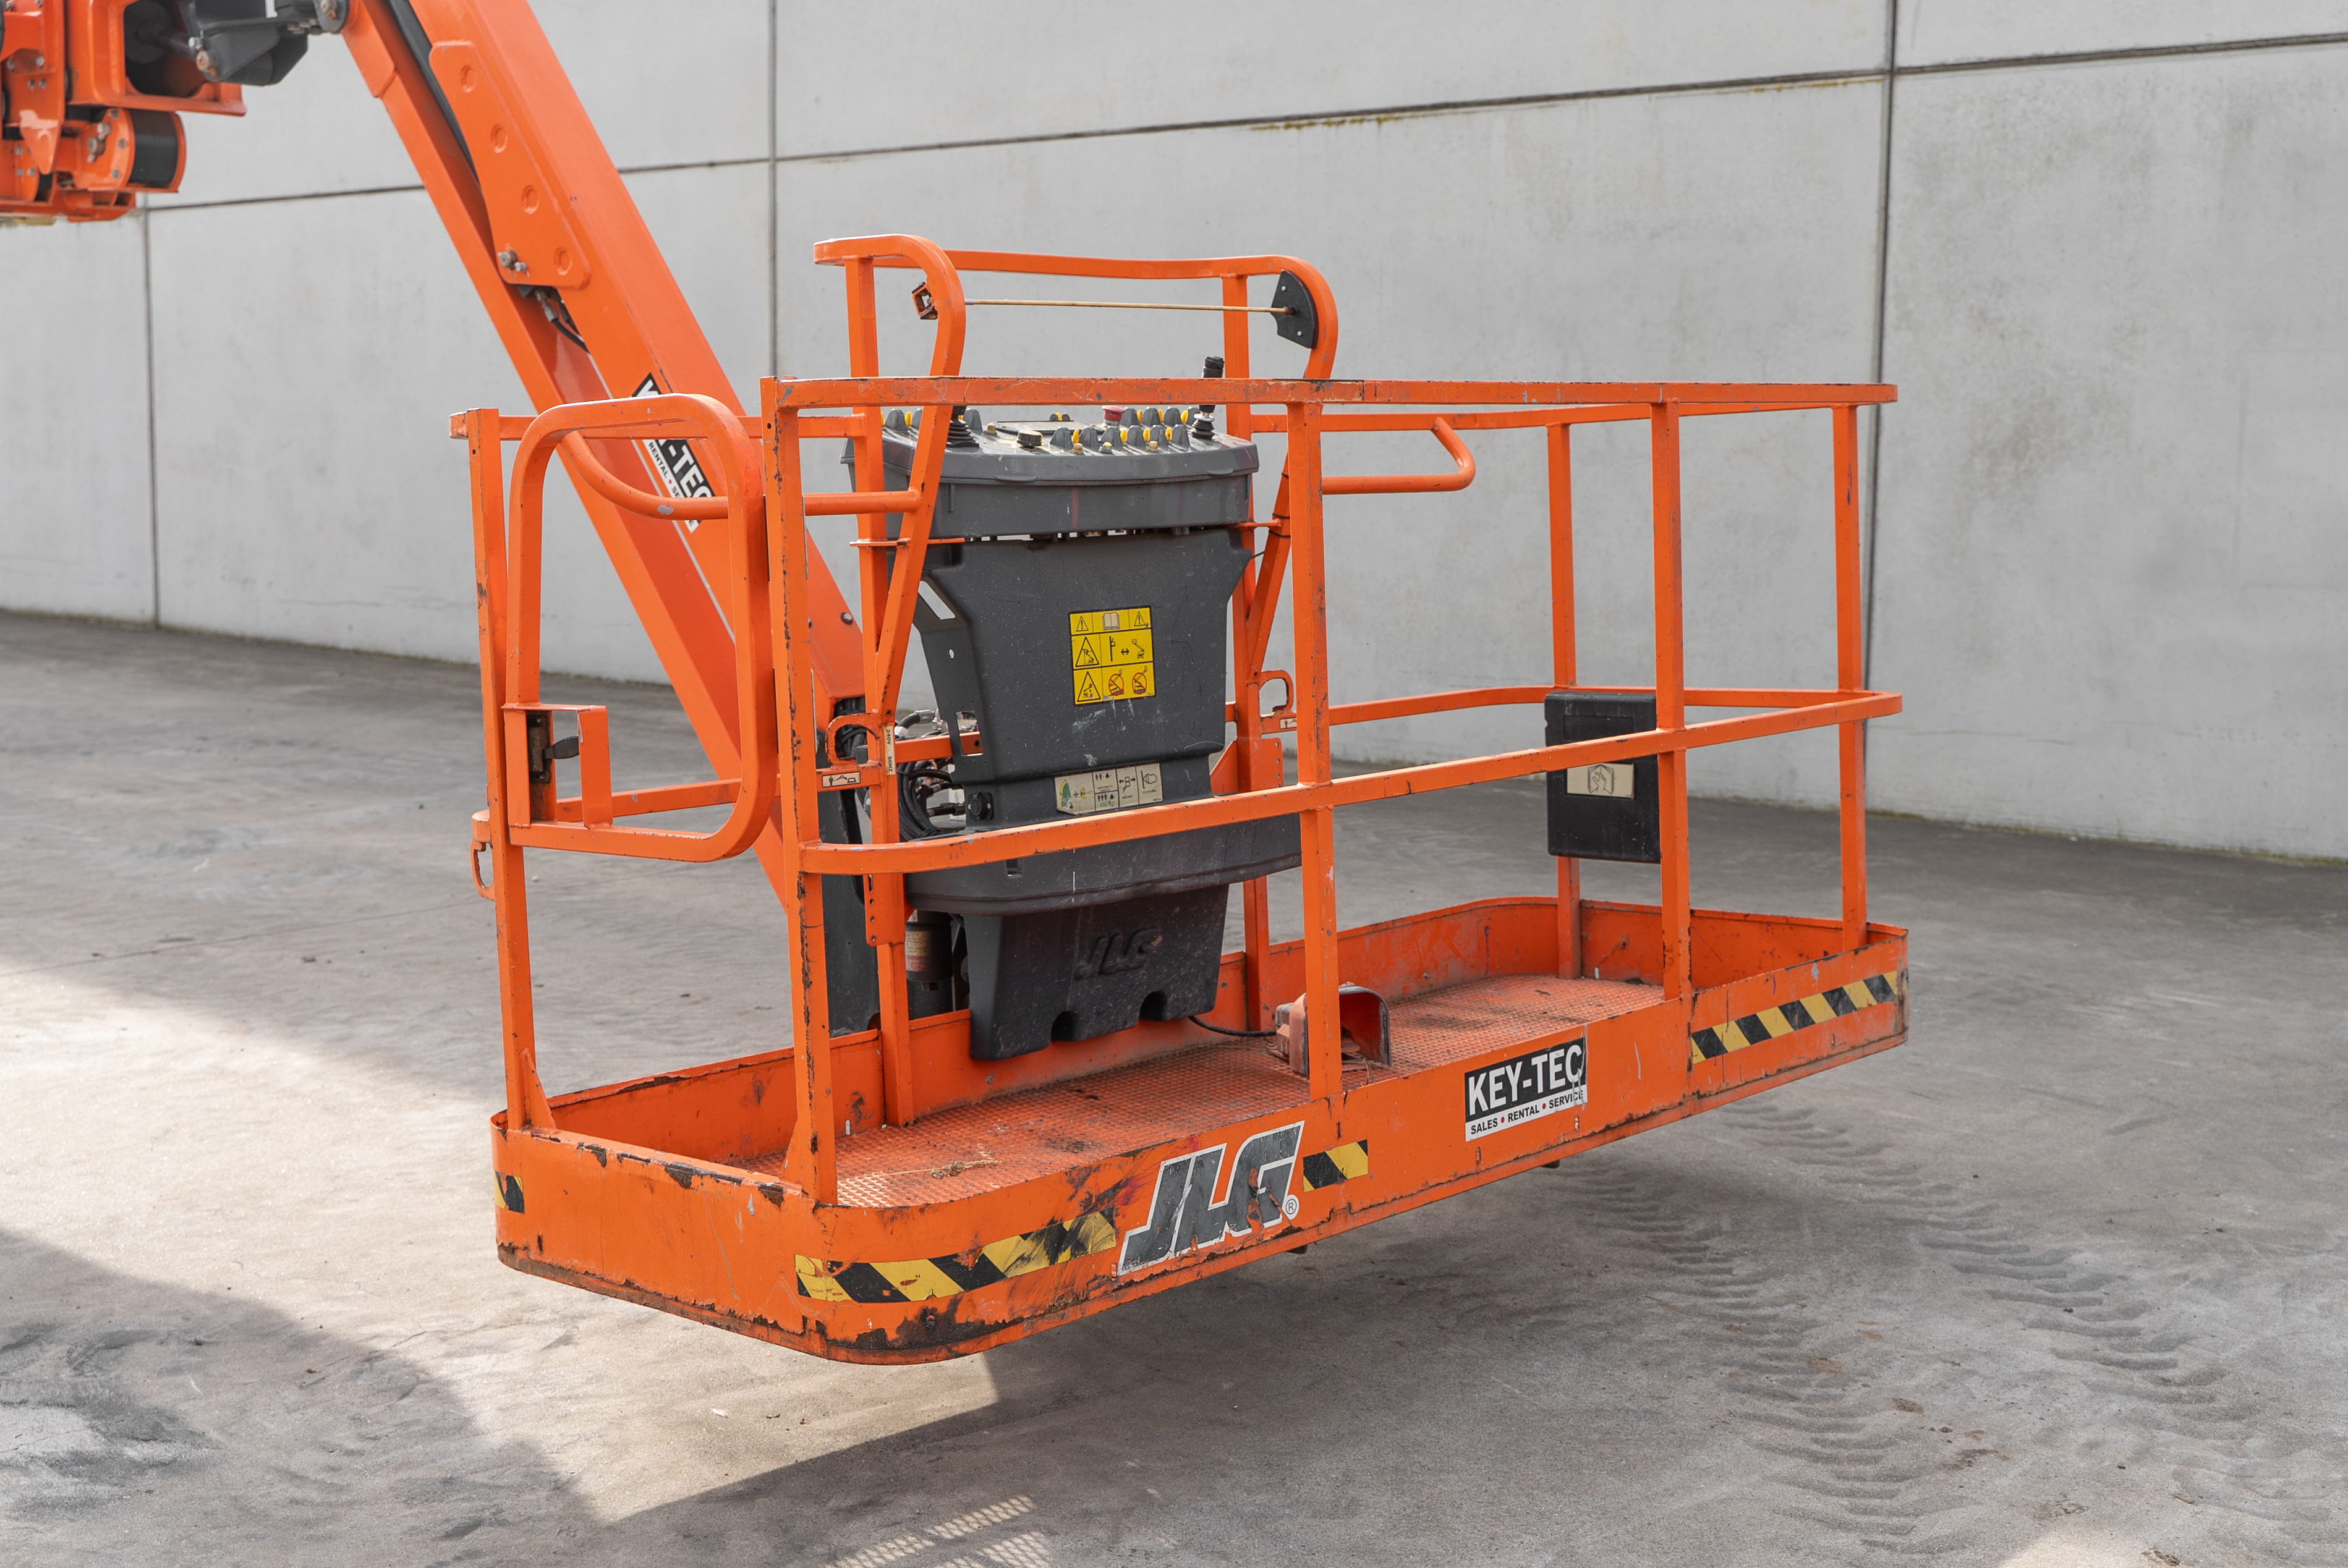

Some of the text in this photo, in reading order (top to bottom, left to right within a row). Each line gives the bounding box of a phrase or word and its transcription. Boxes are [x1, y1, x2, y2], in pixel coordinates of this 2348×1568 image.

[649, 442, 668, 478] RENTAL
[1074, 925, 1160, 981] JLG
[1468, 1045, 1582, 1116] KEY-TEC
[1471, 1090, 1583, 1135] SALES RENTAL SERVICE
